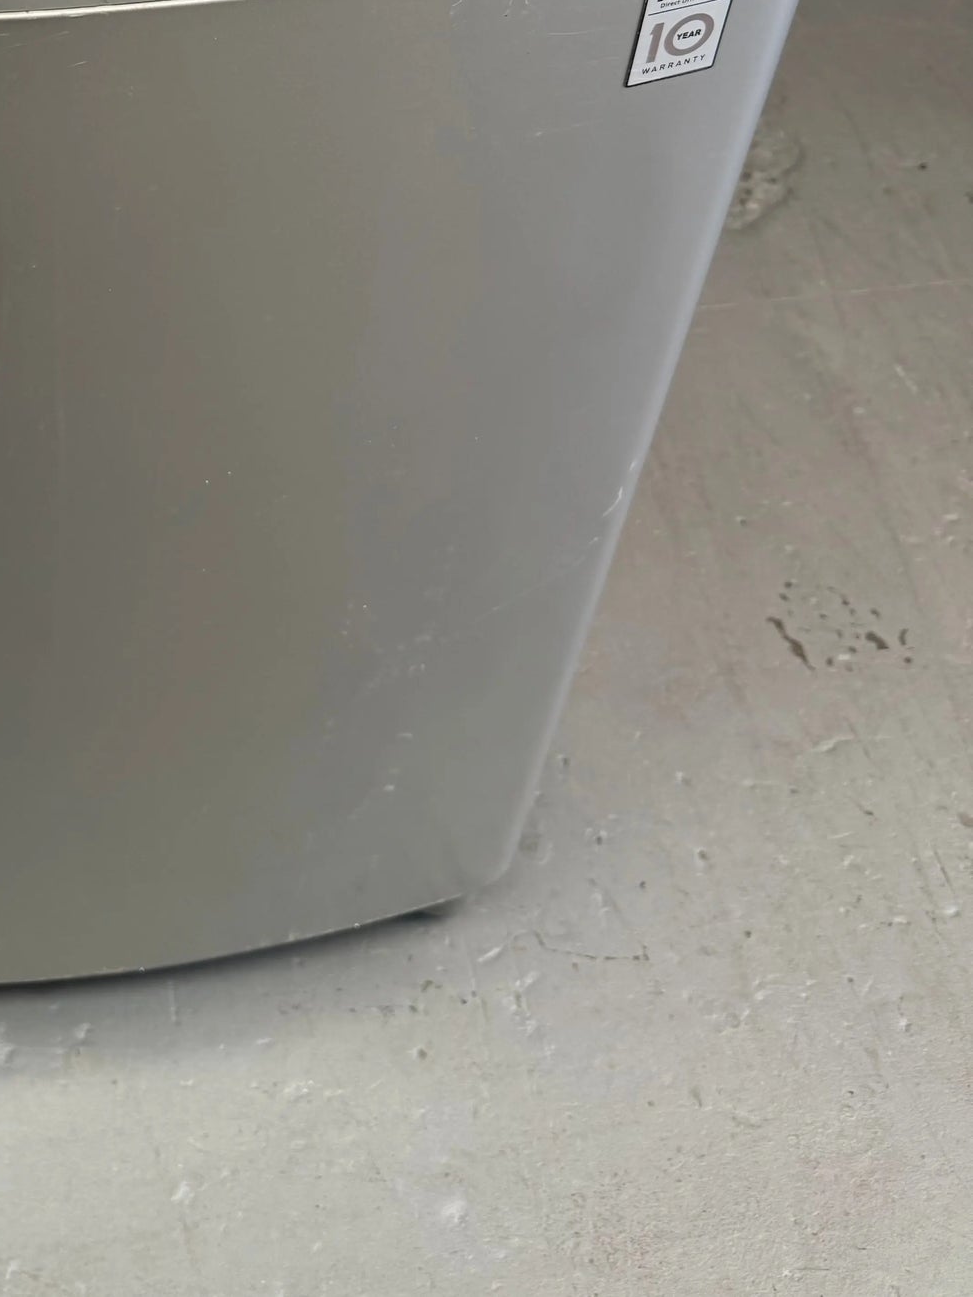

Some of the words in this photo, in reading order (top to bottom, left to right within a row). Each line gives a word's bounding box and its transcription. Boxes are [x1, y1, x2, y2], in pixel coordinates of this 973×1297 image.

[660, 0, 680, 9] Direct
[645, 13, 714, 64] 10
[676, 28, 702, 41] YEAR
[642, 54, 706, 75] WARRANTY
